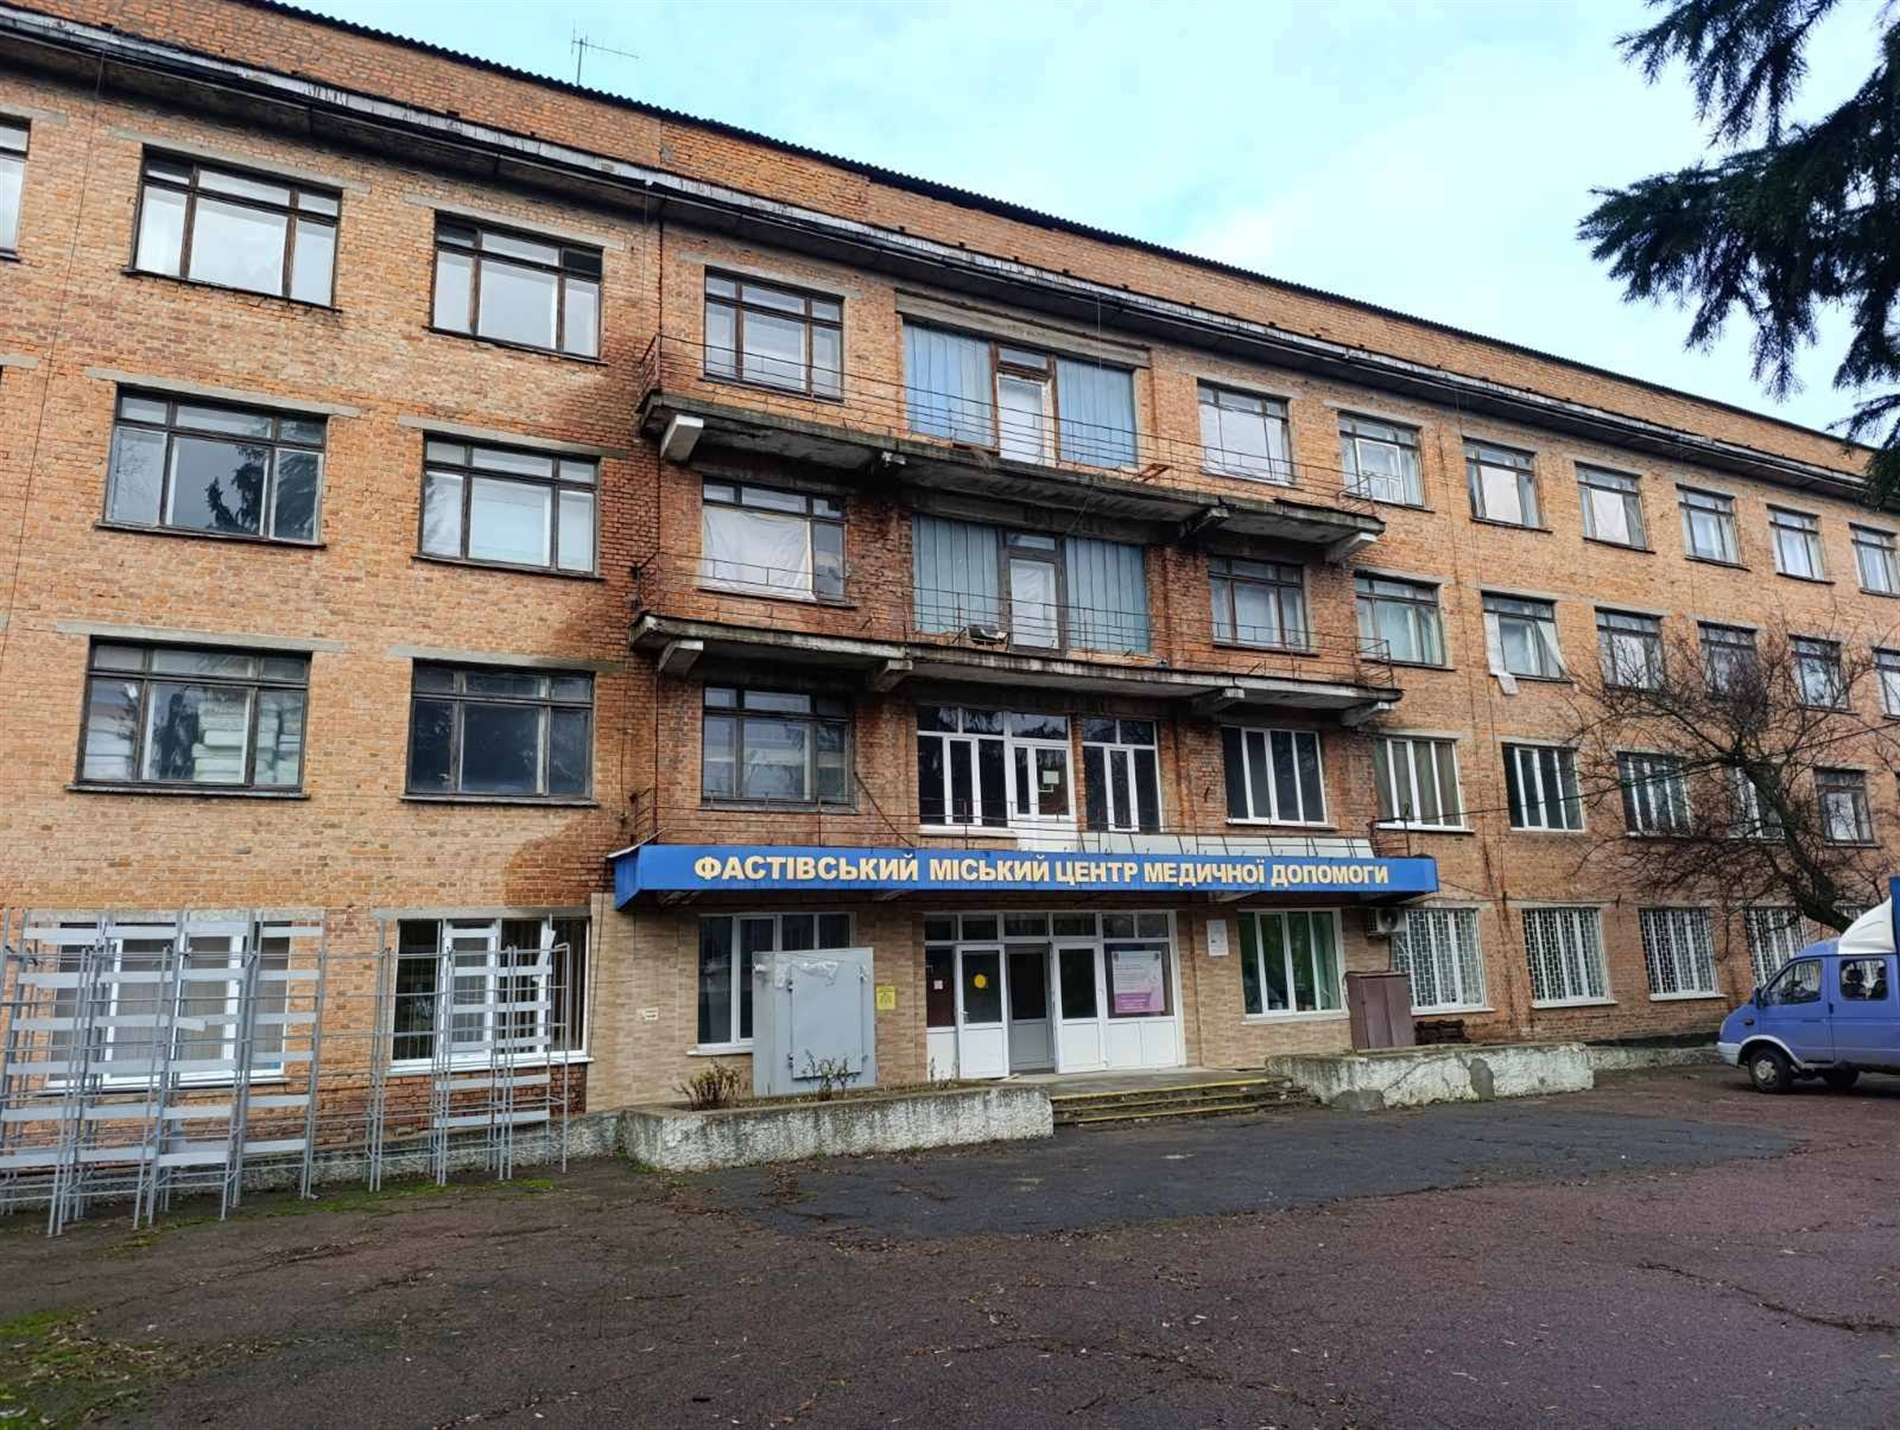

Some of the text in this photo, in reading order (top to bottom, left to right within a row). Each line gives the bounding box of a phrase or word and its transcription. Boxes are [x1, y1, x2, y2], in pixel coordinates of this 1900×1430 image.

[694, 853, 1389, 888] ФАСТІВСЬКИЙ МІСЬКИЙ ЦЕНТР МЕДИЧНОЇ ДОПОМОГИ
